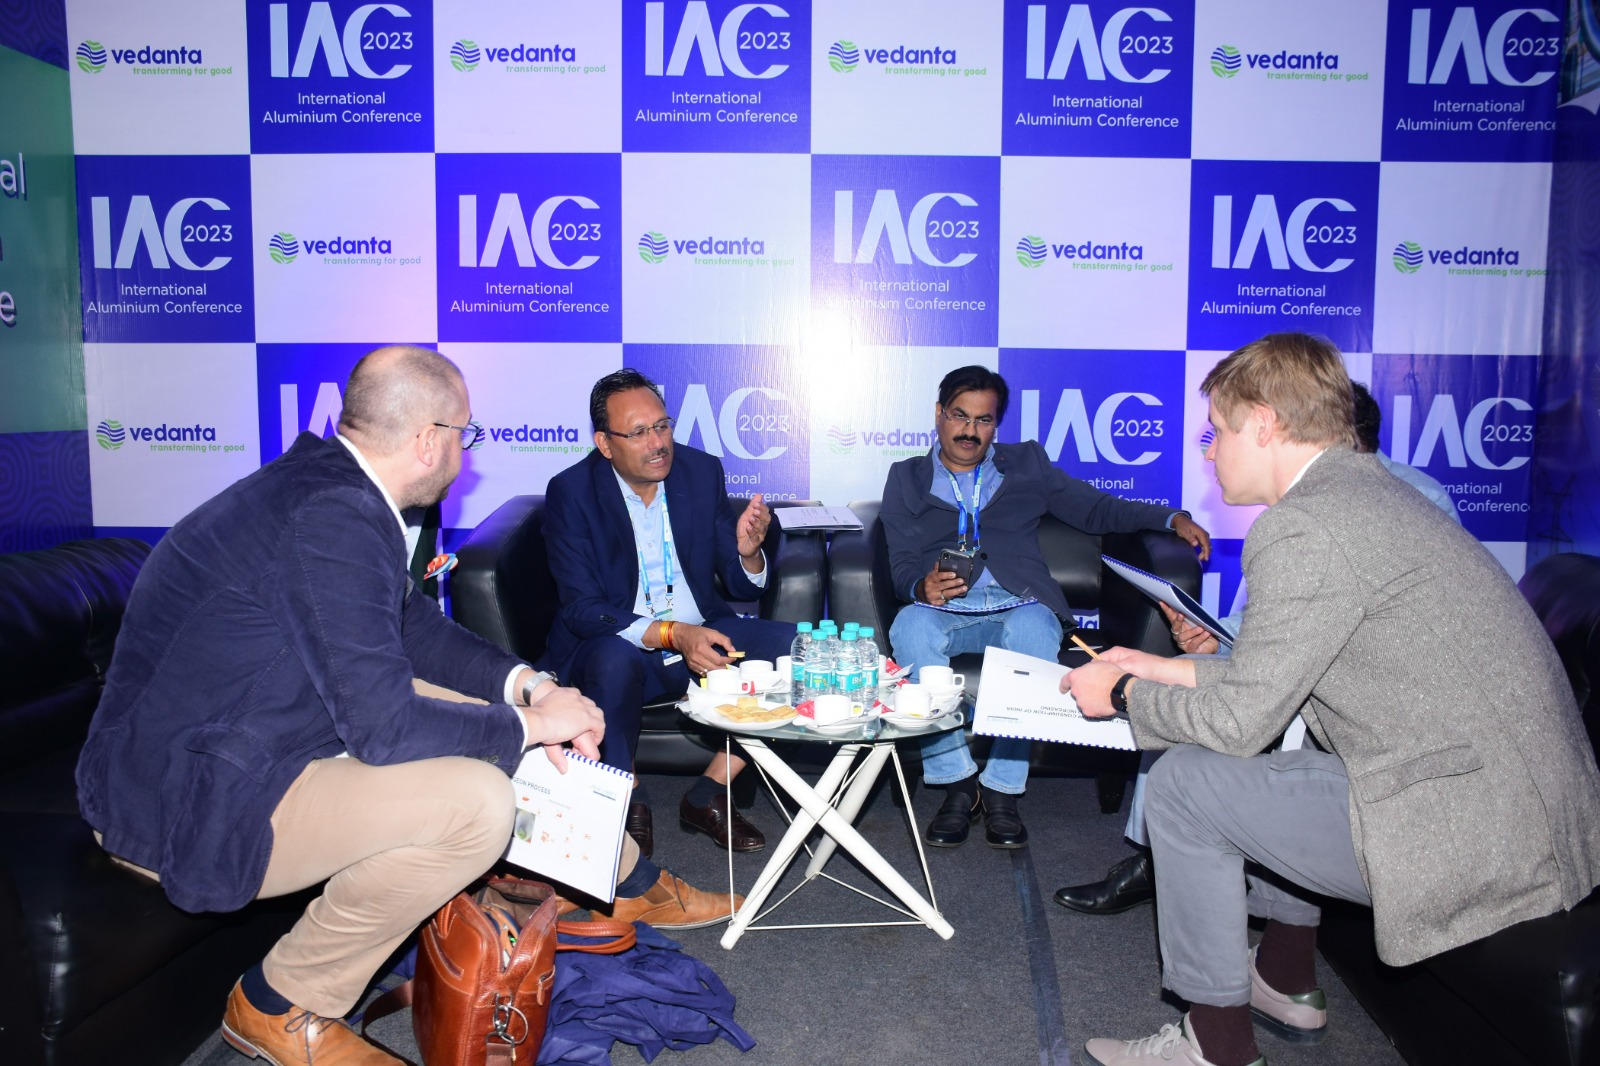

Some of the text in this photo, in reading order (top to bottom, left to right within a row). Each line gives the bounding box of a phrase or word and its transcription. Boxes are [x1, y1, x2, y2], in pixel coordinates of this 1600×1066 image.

[269, 2, 413, 79] IAC 2023
[645, 0, 791, 79] IAC 2023
[1025, 4, 1174, 84] IAC 2023
[1408, 7, 1560, 86] IAC 2023
[111, 45, 202, 64] vedanta
[485, 43, 576, 63] vedanta
[864, 46, 956, 65] vedanta
[1246, 50, 1339, 70] vedanta
[133, 66, 232, 76] transforming for good
[506, 64, 606, 75] transforming for good
[885, 66, 987, 77] transforming for good
[1267, 71, 1368, 82] transforming for good
[298, 92, 386, 106] International
[672, 92, 762, 105] International
[1052, 95, 1142, 109] International
[1433, 99, 1525, 112] International
[263, 110, 422, 124] Aluminium Conference
[636, 110, 798, 123] Aluminium Conference
[1016, 112, 1180, 128] Aluminium Conference
[1396, 117, 1473, 132] Aluminium
[91, 195, 233, 271] IAC 2023
[458, 193, 602, 270] IAC 2023
[834, 189, 980, 268] IAC 2023
[1212, 194, 1357, 272] IAC 2023
[303, 236, 392, 255] vedanta
[674, 236, 764, 255] vedanta
[1052, 240, 1142, 260] vedanta
[324, 256, 422, 266] transforming for good
[694, 257, 794, 268] transforming for good
[1428, 246, 1519, 266] vedanta
[1073, 260, 1172, 272] transforming for good
[1448, 268, 1508, 278] transforming
[1510, 268, 1524, 276] for
[121, 283, 207, 296] International
[486, 282, 574, 295] International
[860, 280, 950, 292] International
[1237, 284, 1326, 298] International
[87, 301, 242, 314] Aluminium Conference
[451, 300, 610, 314] Aluminium Conference
[904, 298, 986, 311] Conference
[1201, 301, 1362, 316] Aluminium Conference
[280, 382, 343, 453] IA
[656, 384, 790, 460] AC 2023
[130, 424, 216, 442] vedanta
[490, 424, 578, 442] vedanta
[1021, 388, 1164, 465] IAC 2023
[1391, 394, 1533, 470] IAC 2023
[862, 429, 938, 447] vedant
[150, 442, 245, 454] transforming for good
[510, 444, 568, 454] transforming
[571, 444, 584, 453] for
